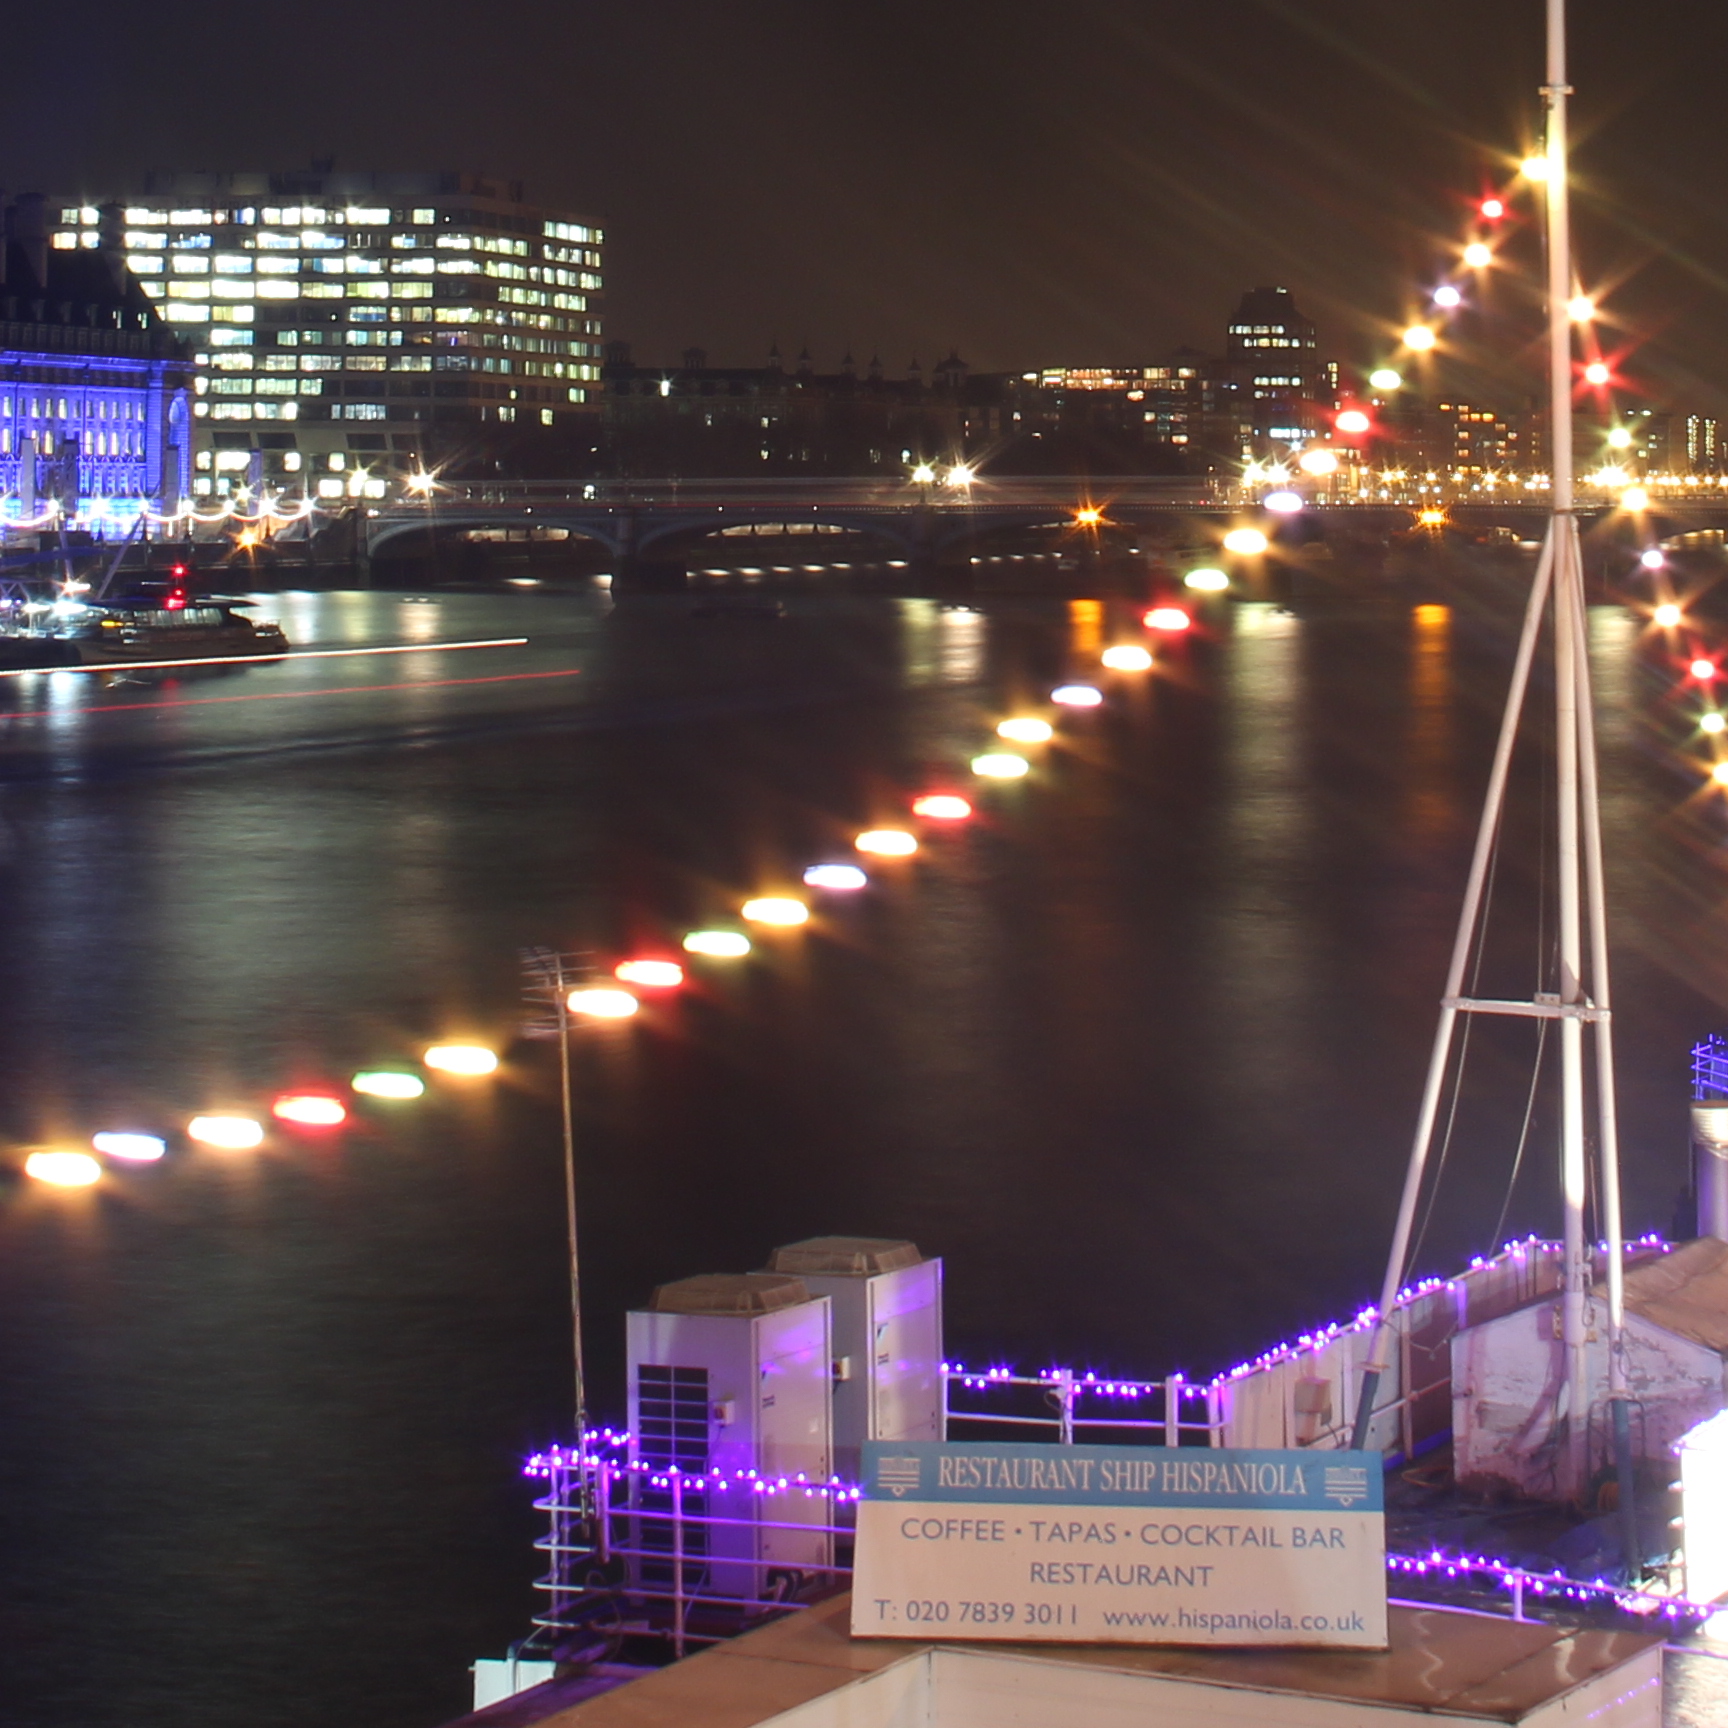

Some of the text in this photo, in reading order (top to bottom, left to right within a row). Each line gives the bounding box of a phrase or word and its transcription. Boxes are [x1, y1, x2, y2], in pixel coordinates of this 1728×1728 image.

[938, 1456, 1308, 1495] RESTAURANT SHIP HISPANIOLA
[901, 1517, 1346, 1549] COFFEE TAPAS COCKTAIL BAR
[1030, 1562, 1214, 1587] RESTAURANT
[874, 1599, 1365, 1634] T: 020 7839 3011 www.hispaniola.co.uk
